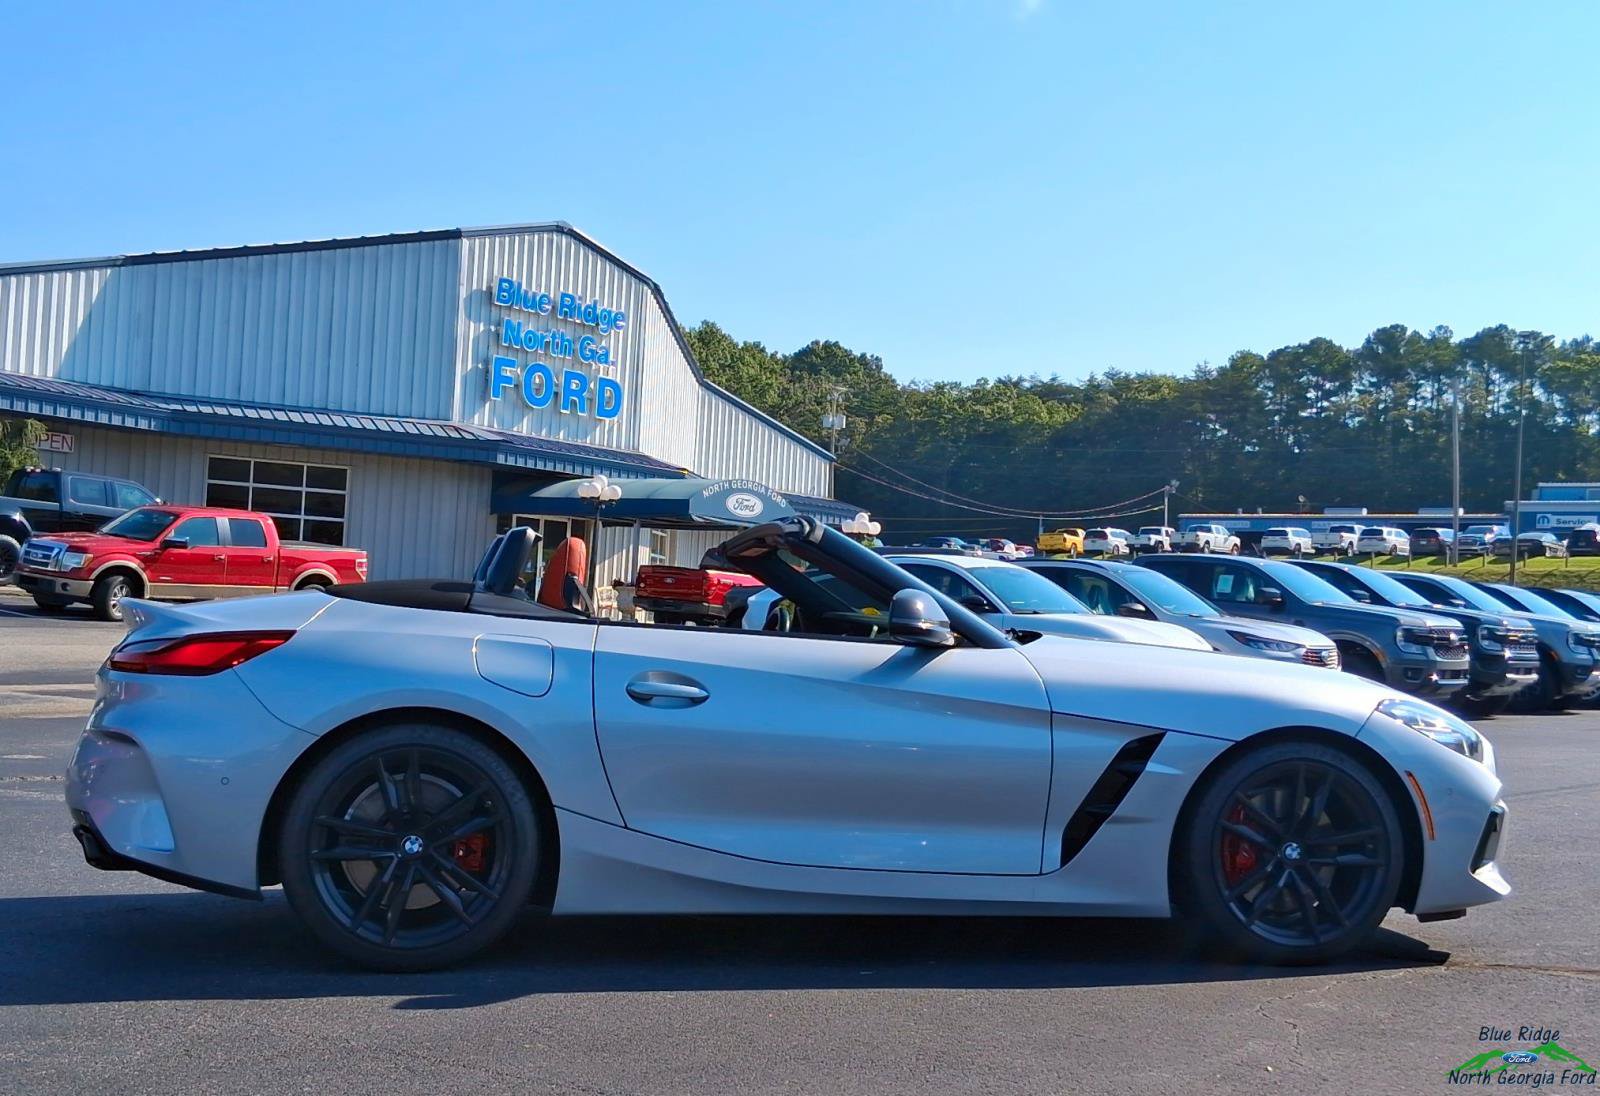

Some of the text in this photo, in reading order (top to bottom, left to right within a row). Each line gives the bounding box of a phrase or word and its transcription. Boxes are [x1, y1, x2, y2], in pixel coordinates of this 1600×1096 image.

[495, 277, 626, 335] Blue Ridge
[502, 317, 616, 369] North Ga.
[491, 354, 623, 420] FORD
[703, 480, 786, 508] NORTH GEORGIA FORD
[733, 497, 756, 512] Ford
